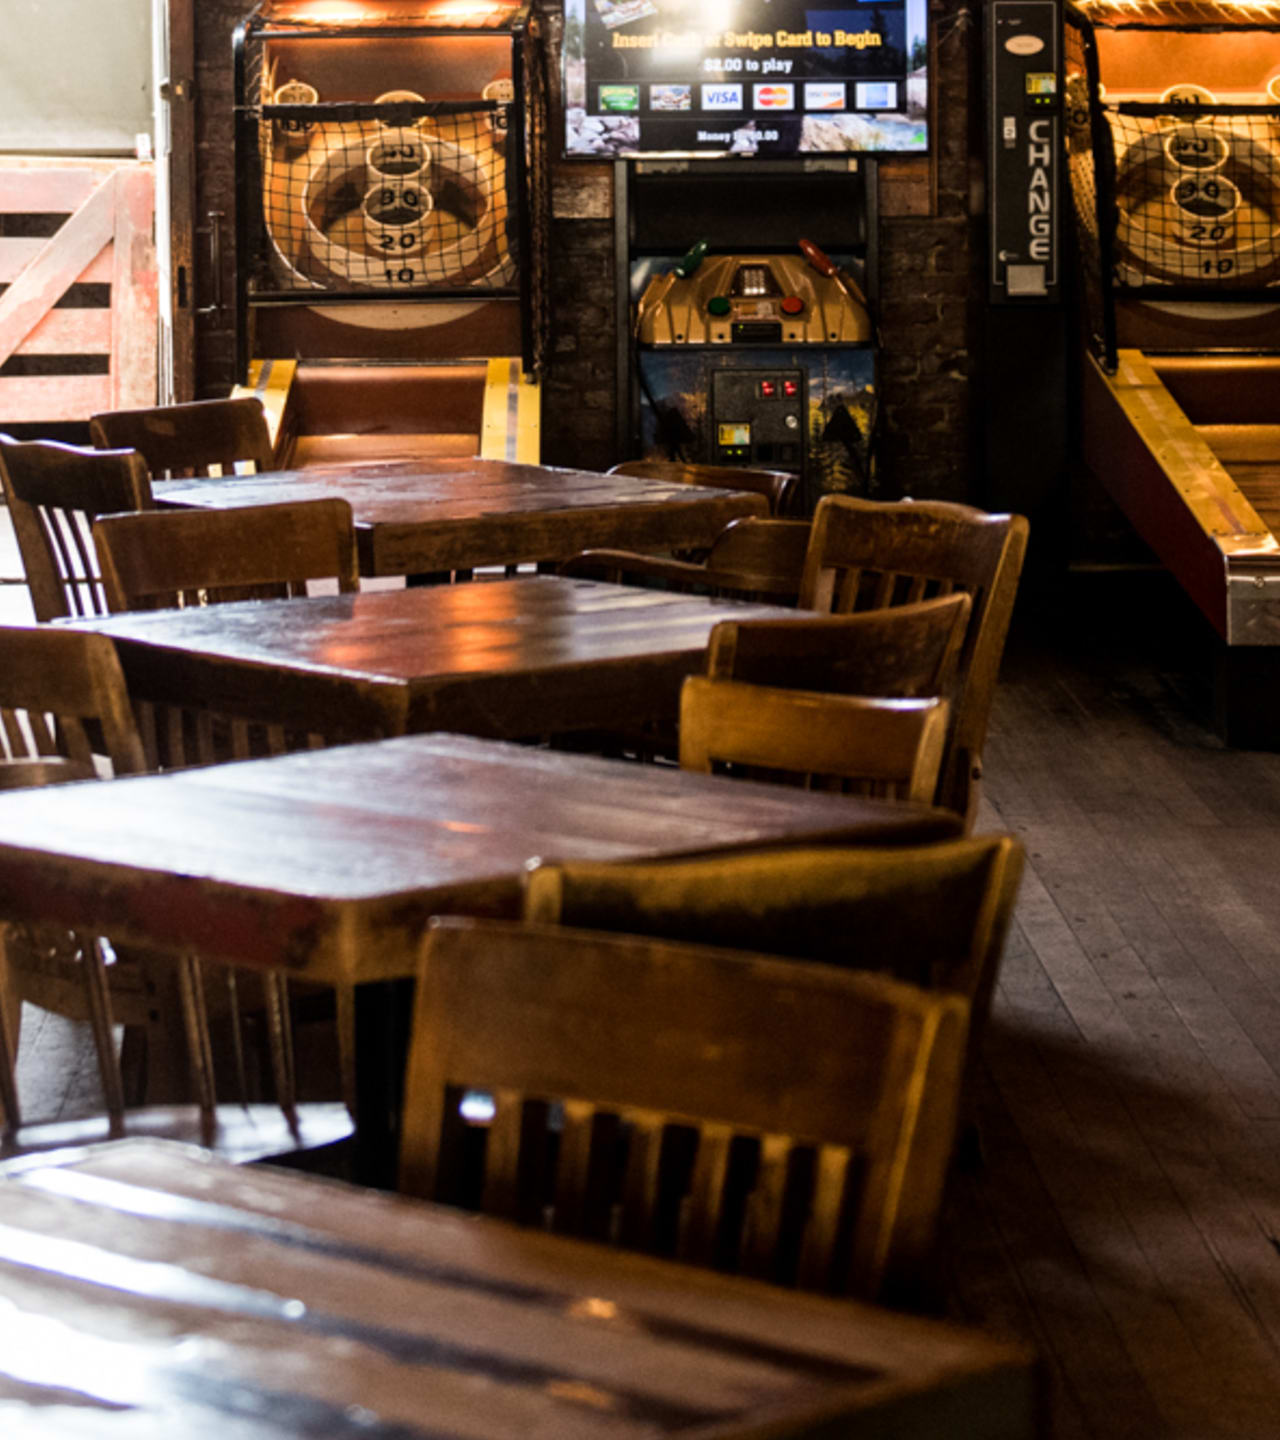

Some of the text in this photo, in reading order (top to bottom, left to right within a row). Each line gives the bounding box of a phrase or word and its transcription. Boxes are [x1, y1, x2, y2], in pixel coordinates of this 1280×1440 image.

[724, 30, 773, 51] Swipe
[776, 30, 813, 47] Card
[816, 31, 831, 47] to
[834, 29, 882, 51] Begin
[745, 58, 759, 72] to
[762, 57, 793, 74] play
[707, 91, 739, 104] VISA
[1028, 119, 1051, 260] CHANGE
[1190, 225, 1226, 241] 20
[379, 234, 416, 250] 20
[1203, 258, 1233, 274] 10
[384, 269, 414, 283] 10
